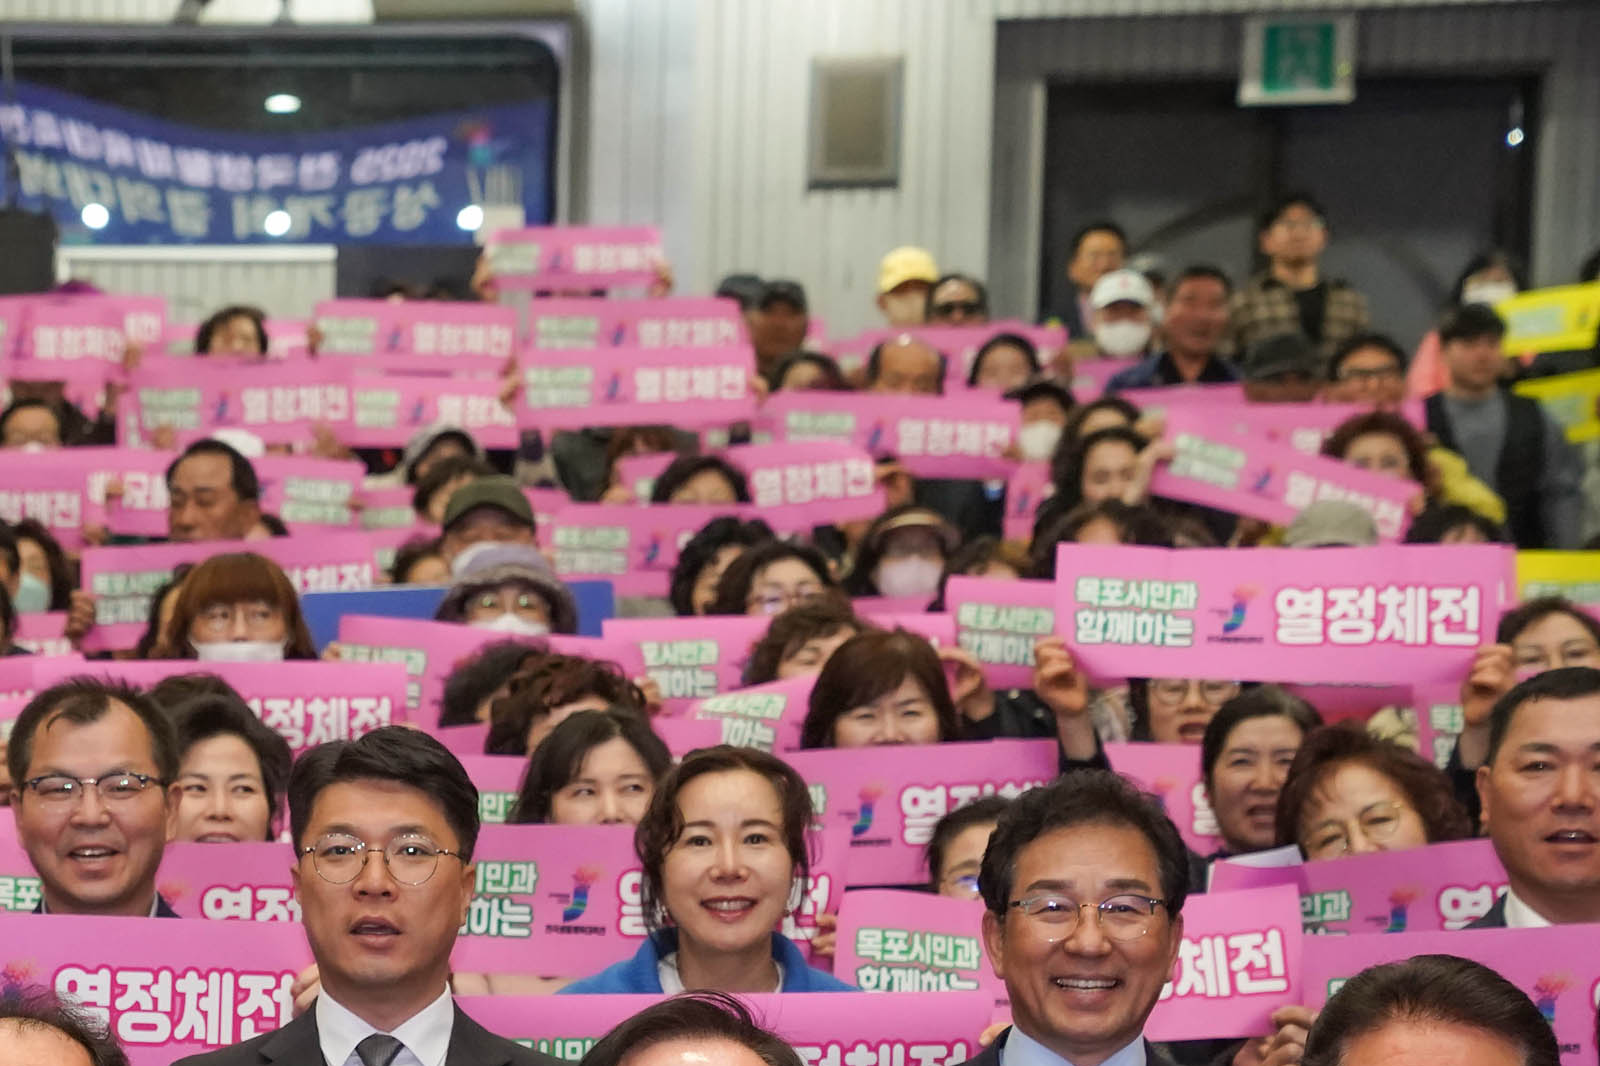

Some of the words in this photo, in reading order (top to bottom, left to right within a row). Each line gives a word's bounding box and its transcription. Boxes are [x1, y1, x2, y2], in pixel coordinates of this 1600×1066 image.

[1075, 577, 1198, 610] 목포시민과
[1273, 584, 1483, 646] 열정체전
[1075, 609, 1194, 647] 함께하는
[248, 696, 391, 748] 정체전
[856, 927, 982, 971] 목포시민과
